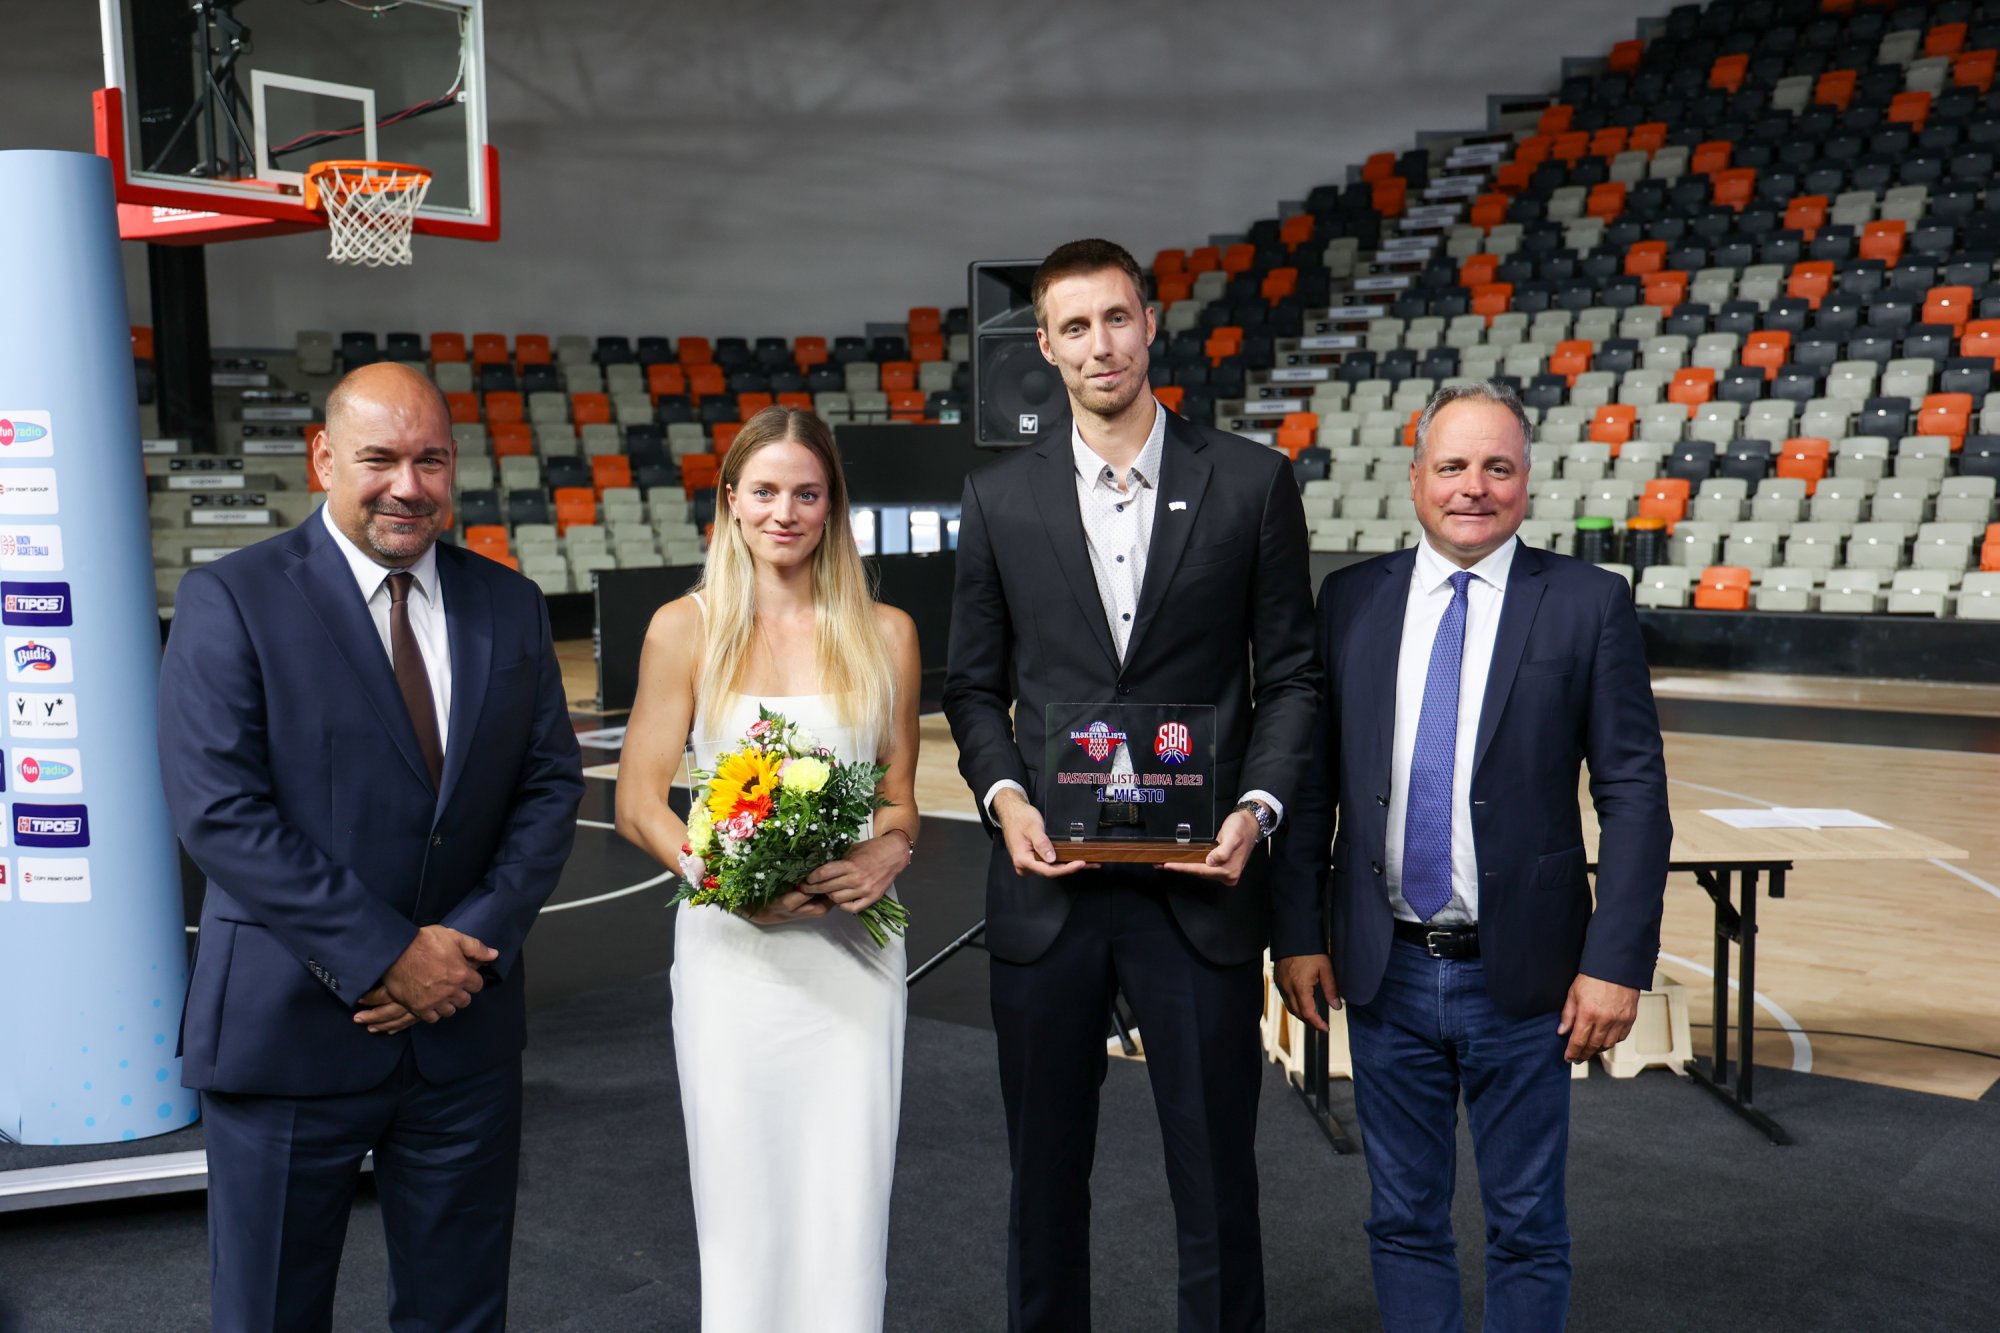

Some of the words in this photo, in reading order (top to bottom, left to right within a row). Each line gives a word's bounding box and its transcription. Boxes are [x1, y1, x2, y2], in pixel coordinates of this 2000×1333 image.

[16, 425, 42, 437] radio
[18, 598, 60, 611] TIPOS
[1070, 731, 1127, 740] BASKETBALISTA
[1159, 722, 1188, 752] SBA
[22, 763, 38, 775] fun
[40, 765, 69, 776] radio
[1057, 772, 1141, 785] BASKETBALISTA
[1143, 773, 1173, 785] ROKA
[1175, 774, 1204, 786] 2023
[1096, 788, 1110, 802] 1.
[1113, 788, 1165, 803] MIESTO
[32, 820, 77, 832] TIPOS
